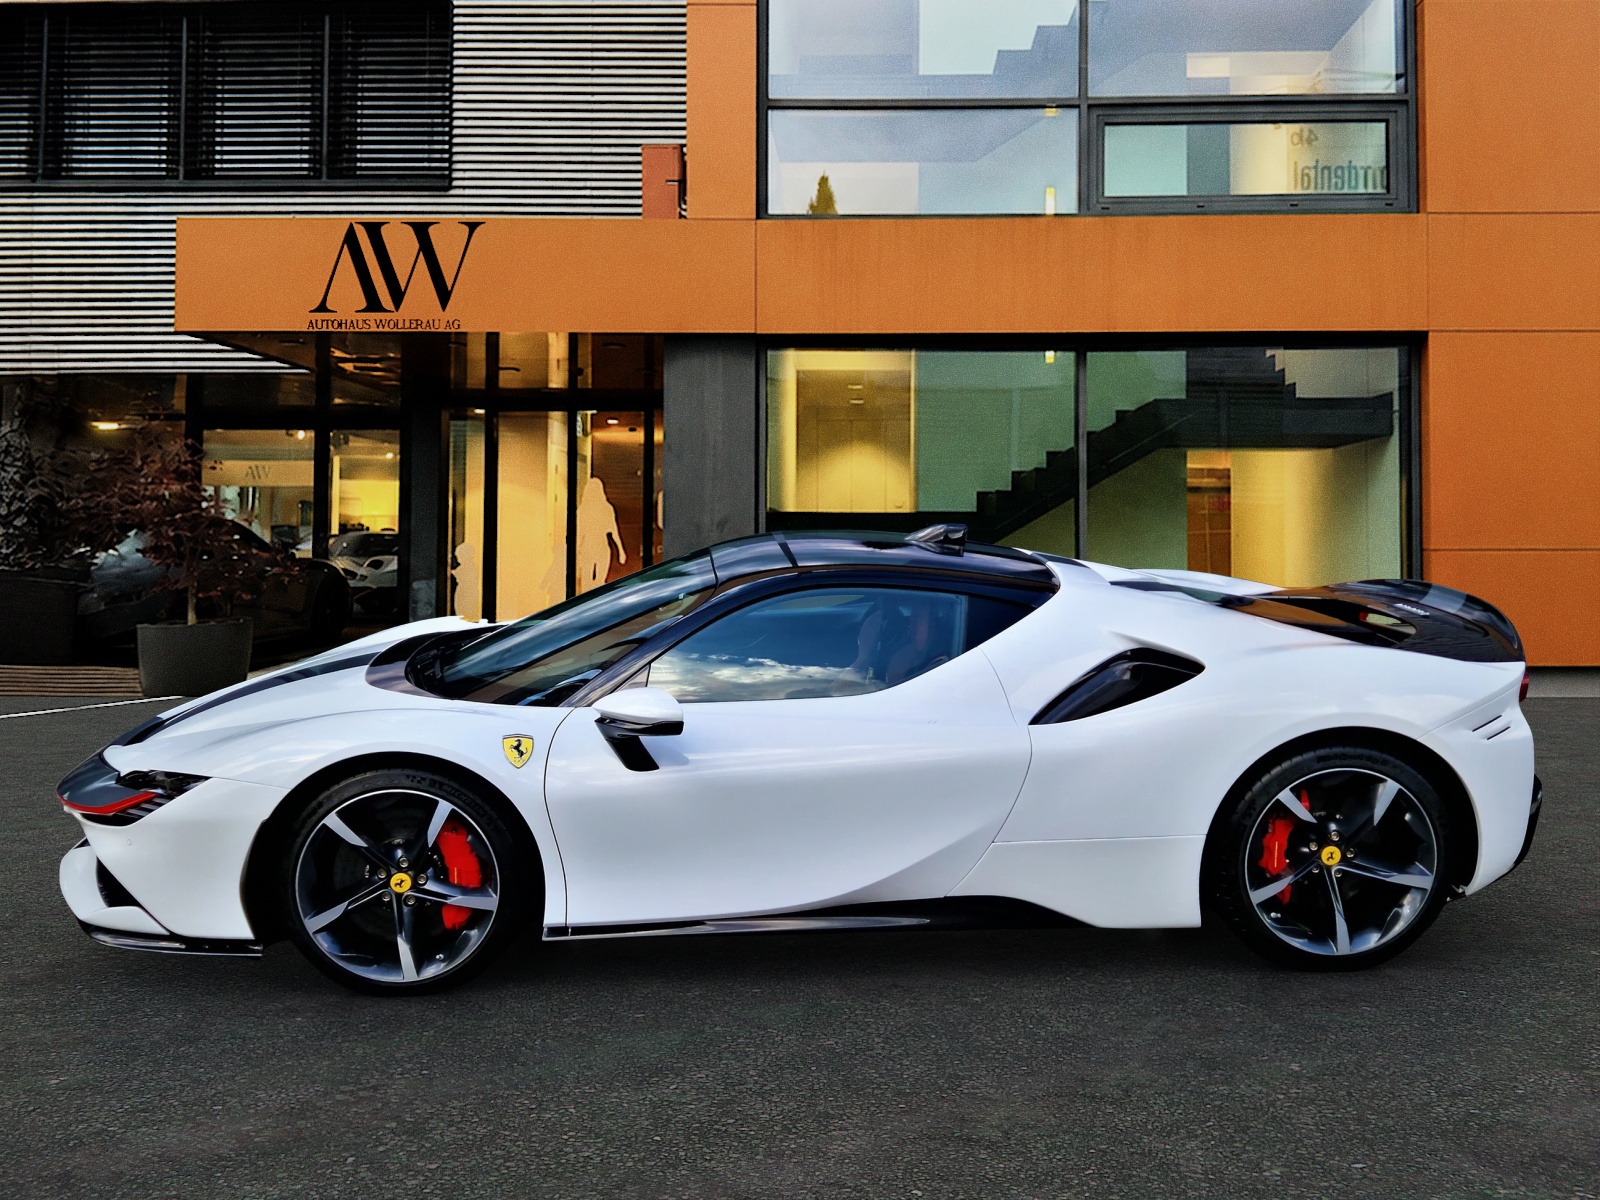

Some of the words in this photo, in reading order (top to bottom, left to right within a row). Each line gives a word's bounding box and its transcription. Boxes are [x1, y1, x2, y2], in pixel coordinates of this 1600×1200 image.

[308, 221, 486, 313] AW
[307, 319, 371, 330] AUTOHAUS
[374, 319, 441, 330] WOLLERAU
[444, 319, 461, 330] AG
